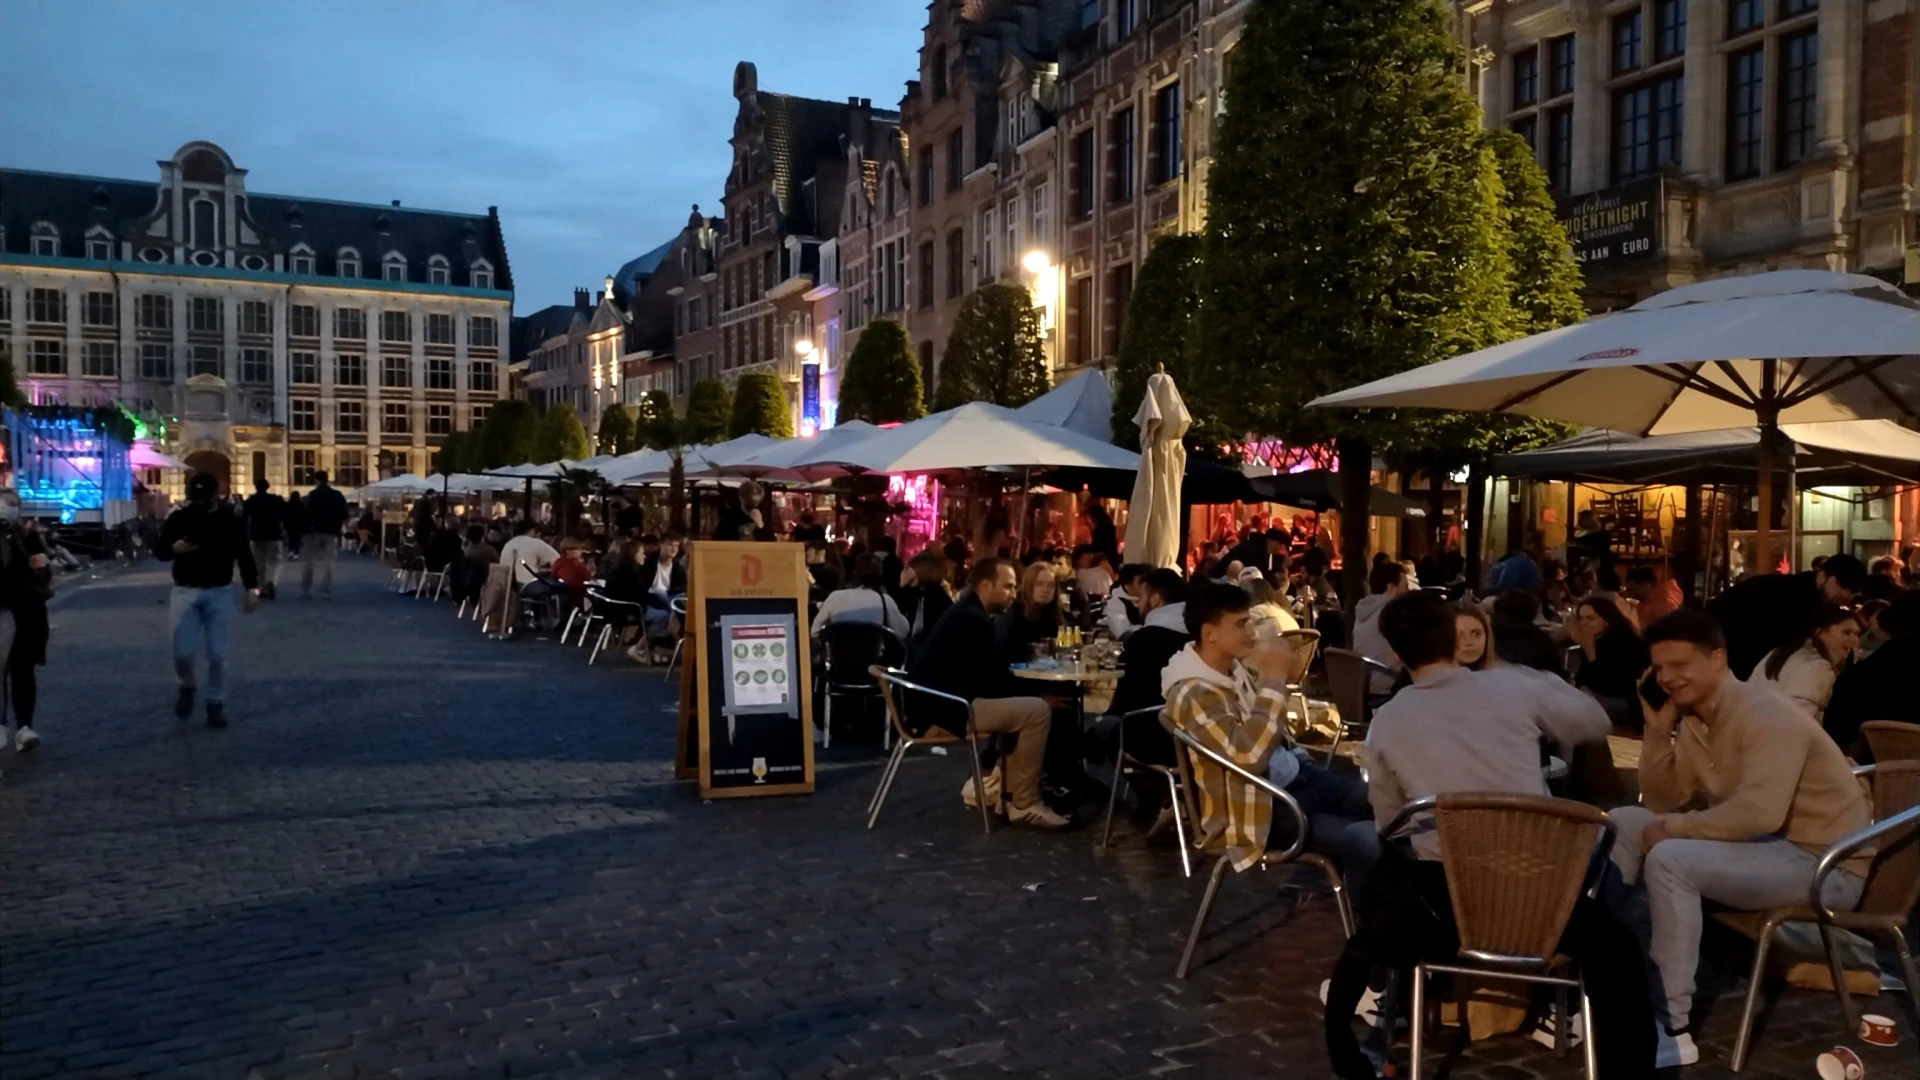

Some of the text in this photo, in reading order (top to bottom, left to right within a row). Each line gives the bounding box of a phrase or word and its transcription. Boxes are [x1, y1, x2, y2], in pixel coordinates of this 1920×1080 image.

[1558, 201, 1648, 235] UDENTNIGHT
[1591, 246, 1609, 261] AAN
[1622, 237, 1649, 255] EURO
